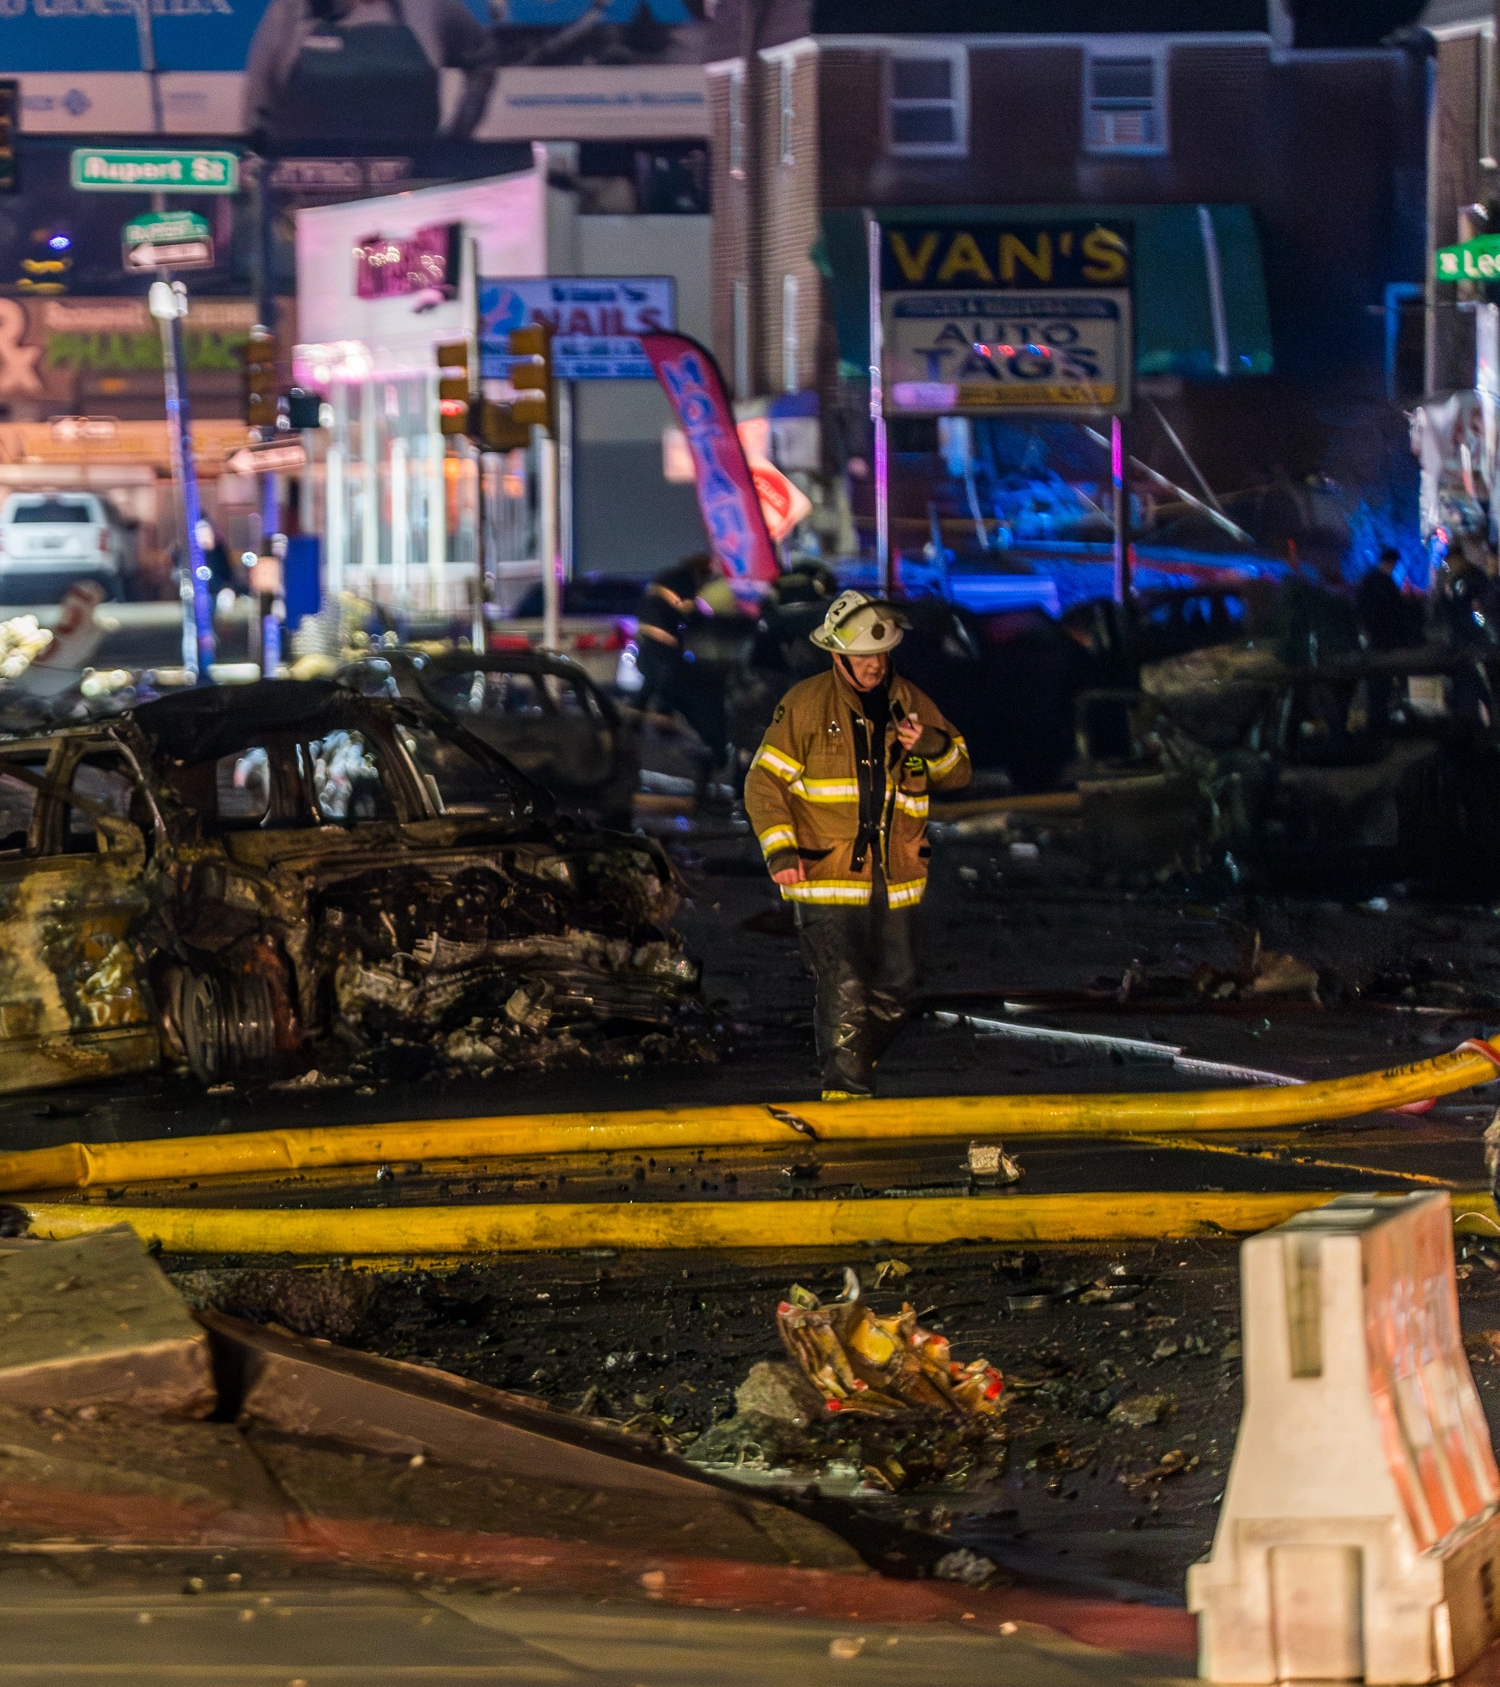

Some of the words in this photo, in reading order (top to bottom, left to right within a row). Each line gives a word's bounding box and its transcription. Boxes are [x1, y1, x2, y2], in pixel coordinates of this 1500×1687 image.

[84, 156, 182, 183] Rupert
[191, 157, 226, 182] St
[887, 226, 1129, 283] VAN'S
[529, 306, 664, 337] NAILS
[933, 322, 1080, 345] AUTO
[913, 346, 1101, 381] TAGS
[832, 600, 848, 617] 2
